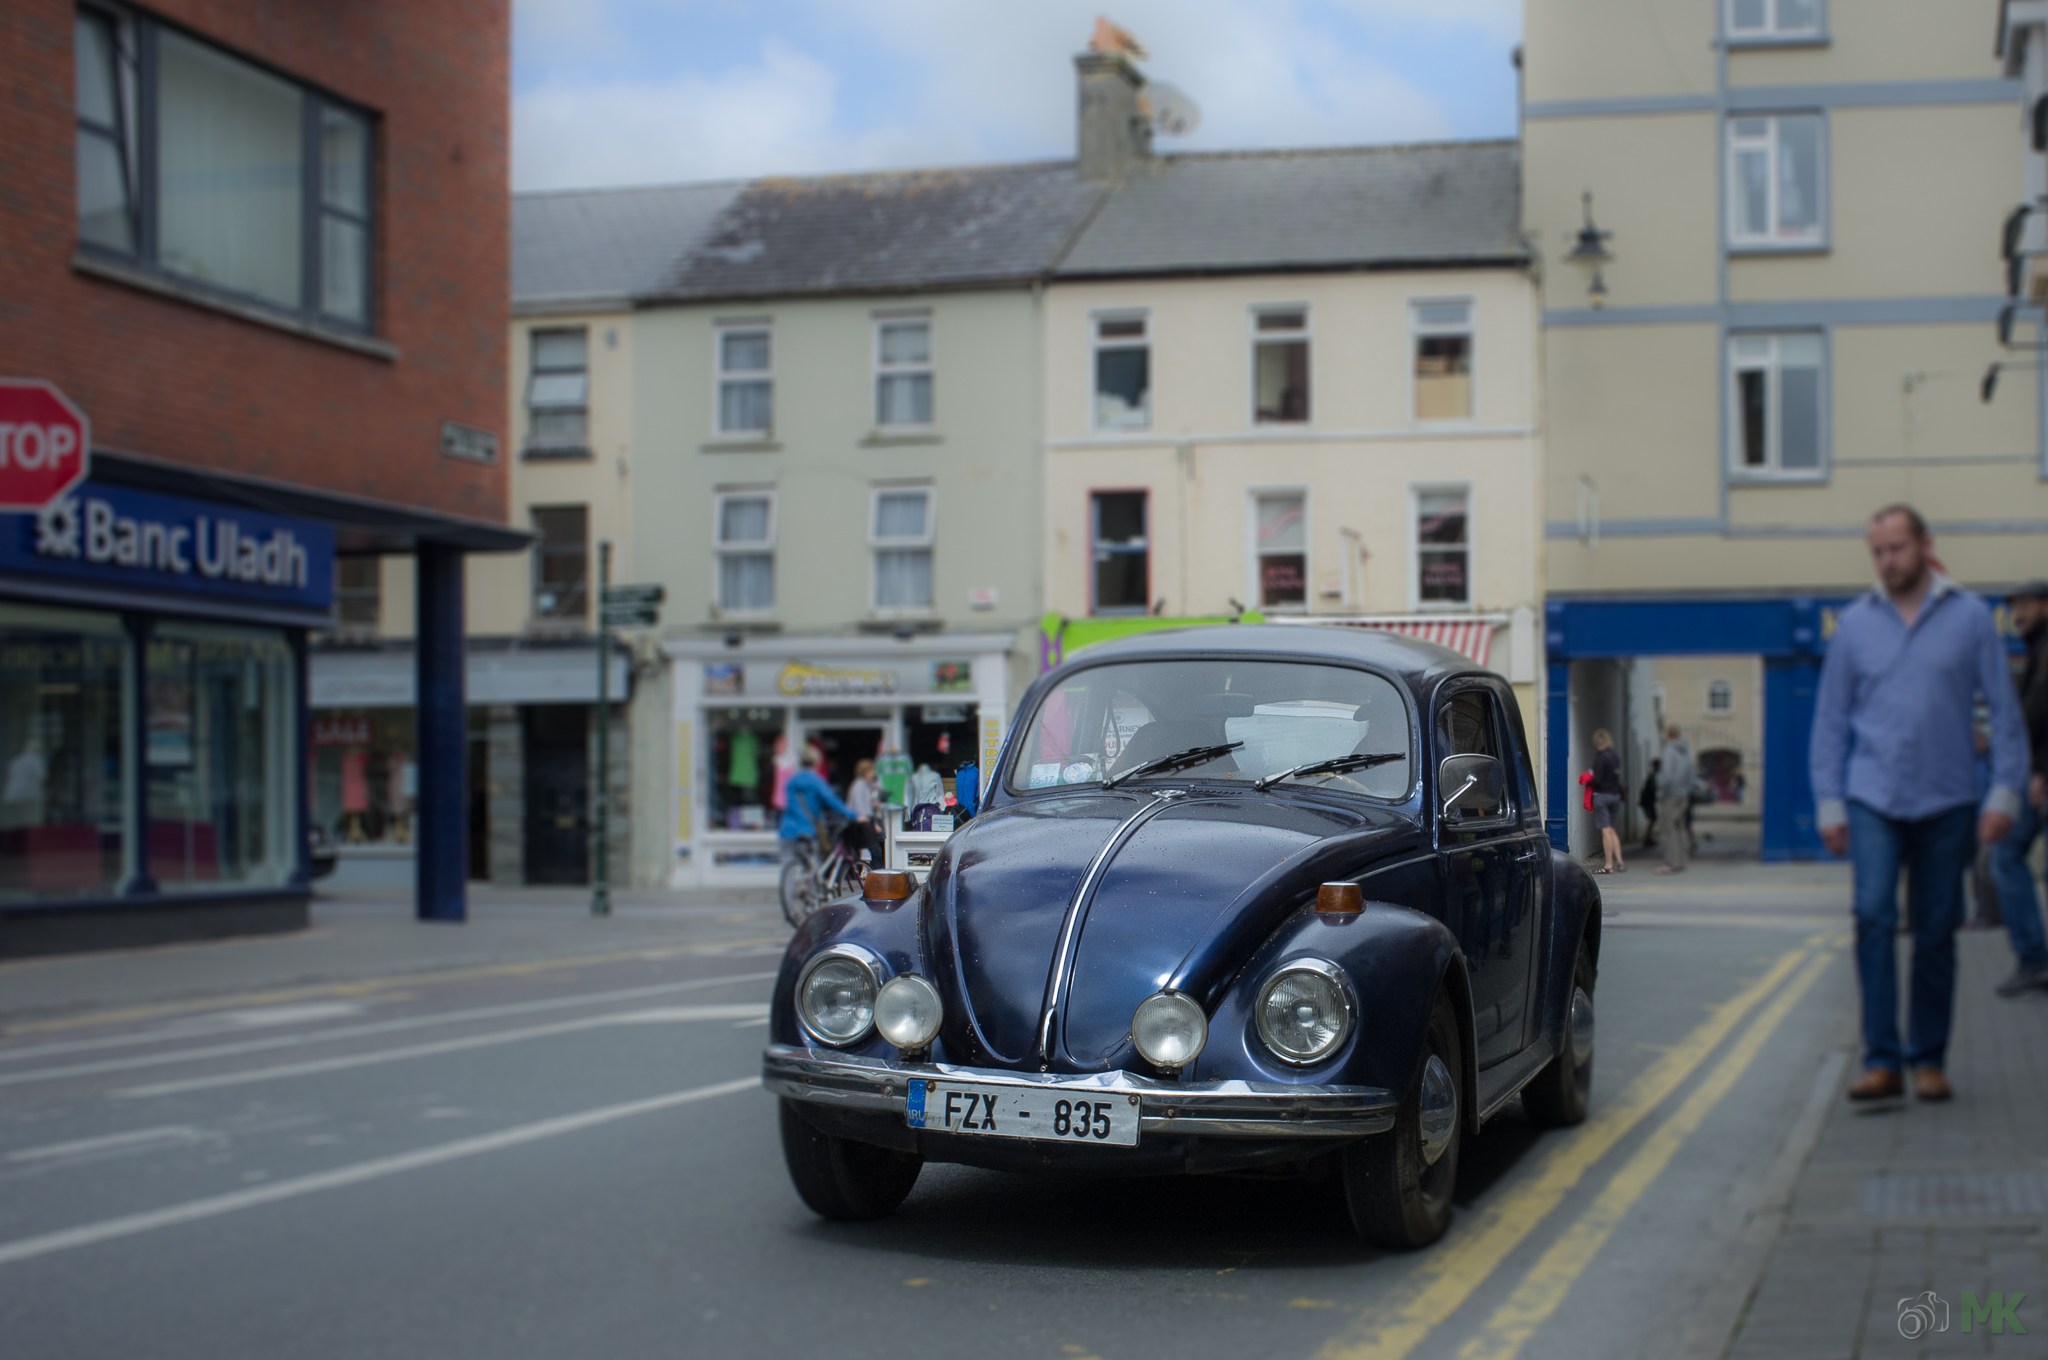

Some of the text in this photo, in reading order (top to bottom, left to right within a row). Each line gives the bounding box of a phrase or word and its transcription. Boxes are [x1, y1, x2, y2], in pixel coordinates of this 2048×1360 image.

[0, 422, 75, 470] TOP
[85, 498, 308, 588] Banc Uladh
[945, 1091, 997, 1130] FZX
[1054, 1099, 1113, 1140] 835
